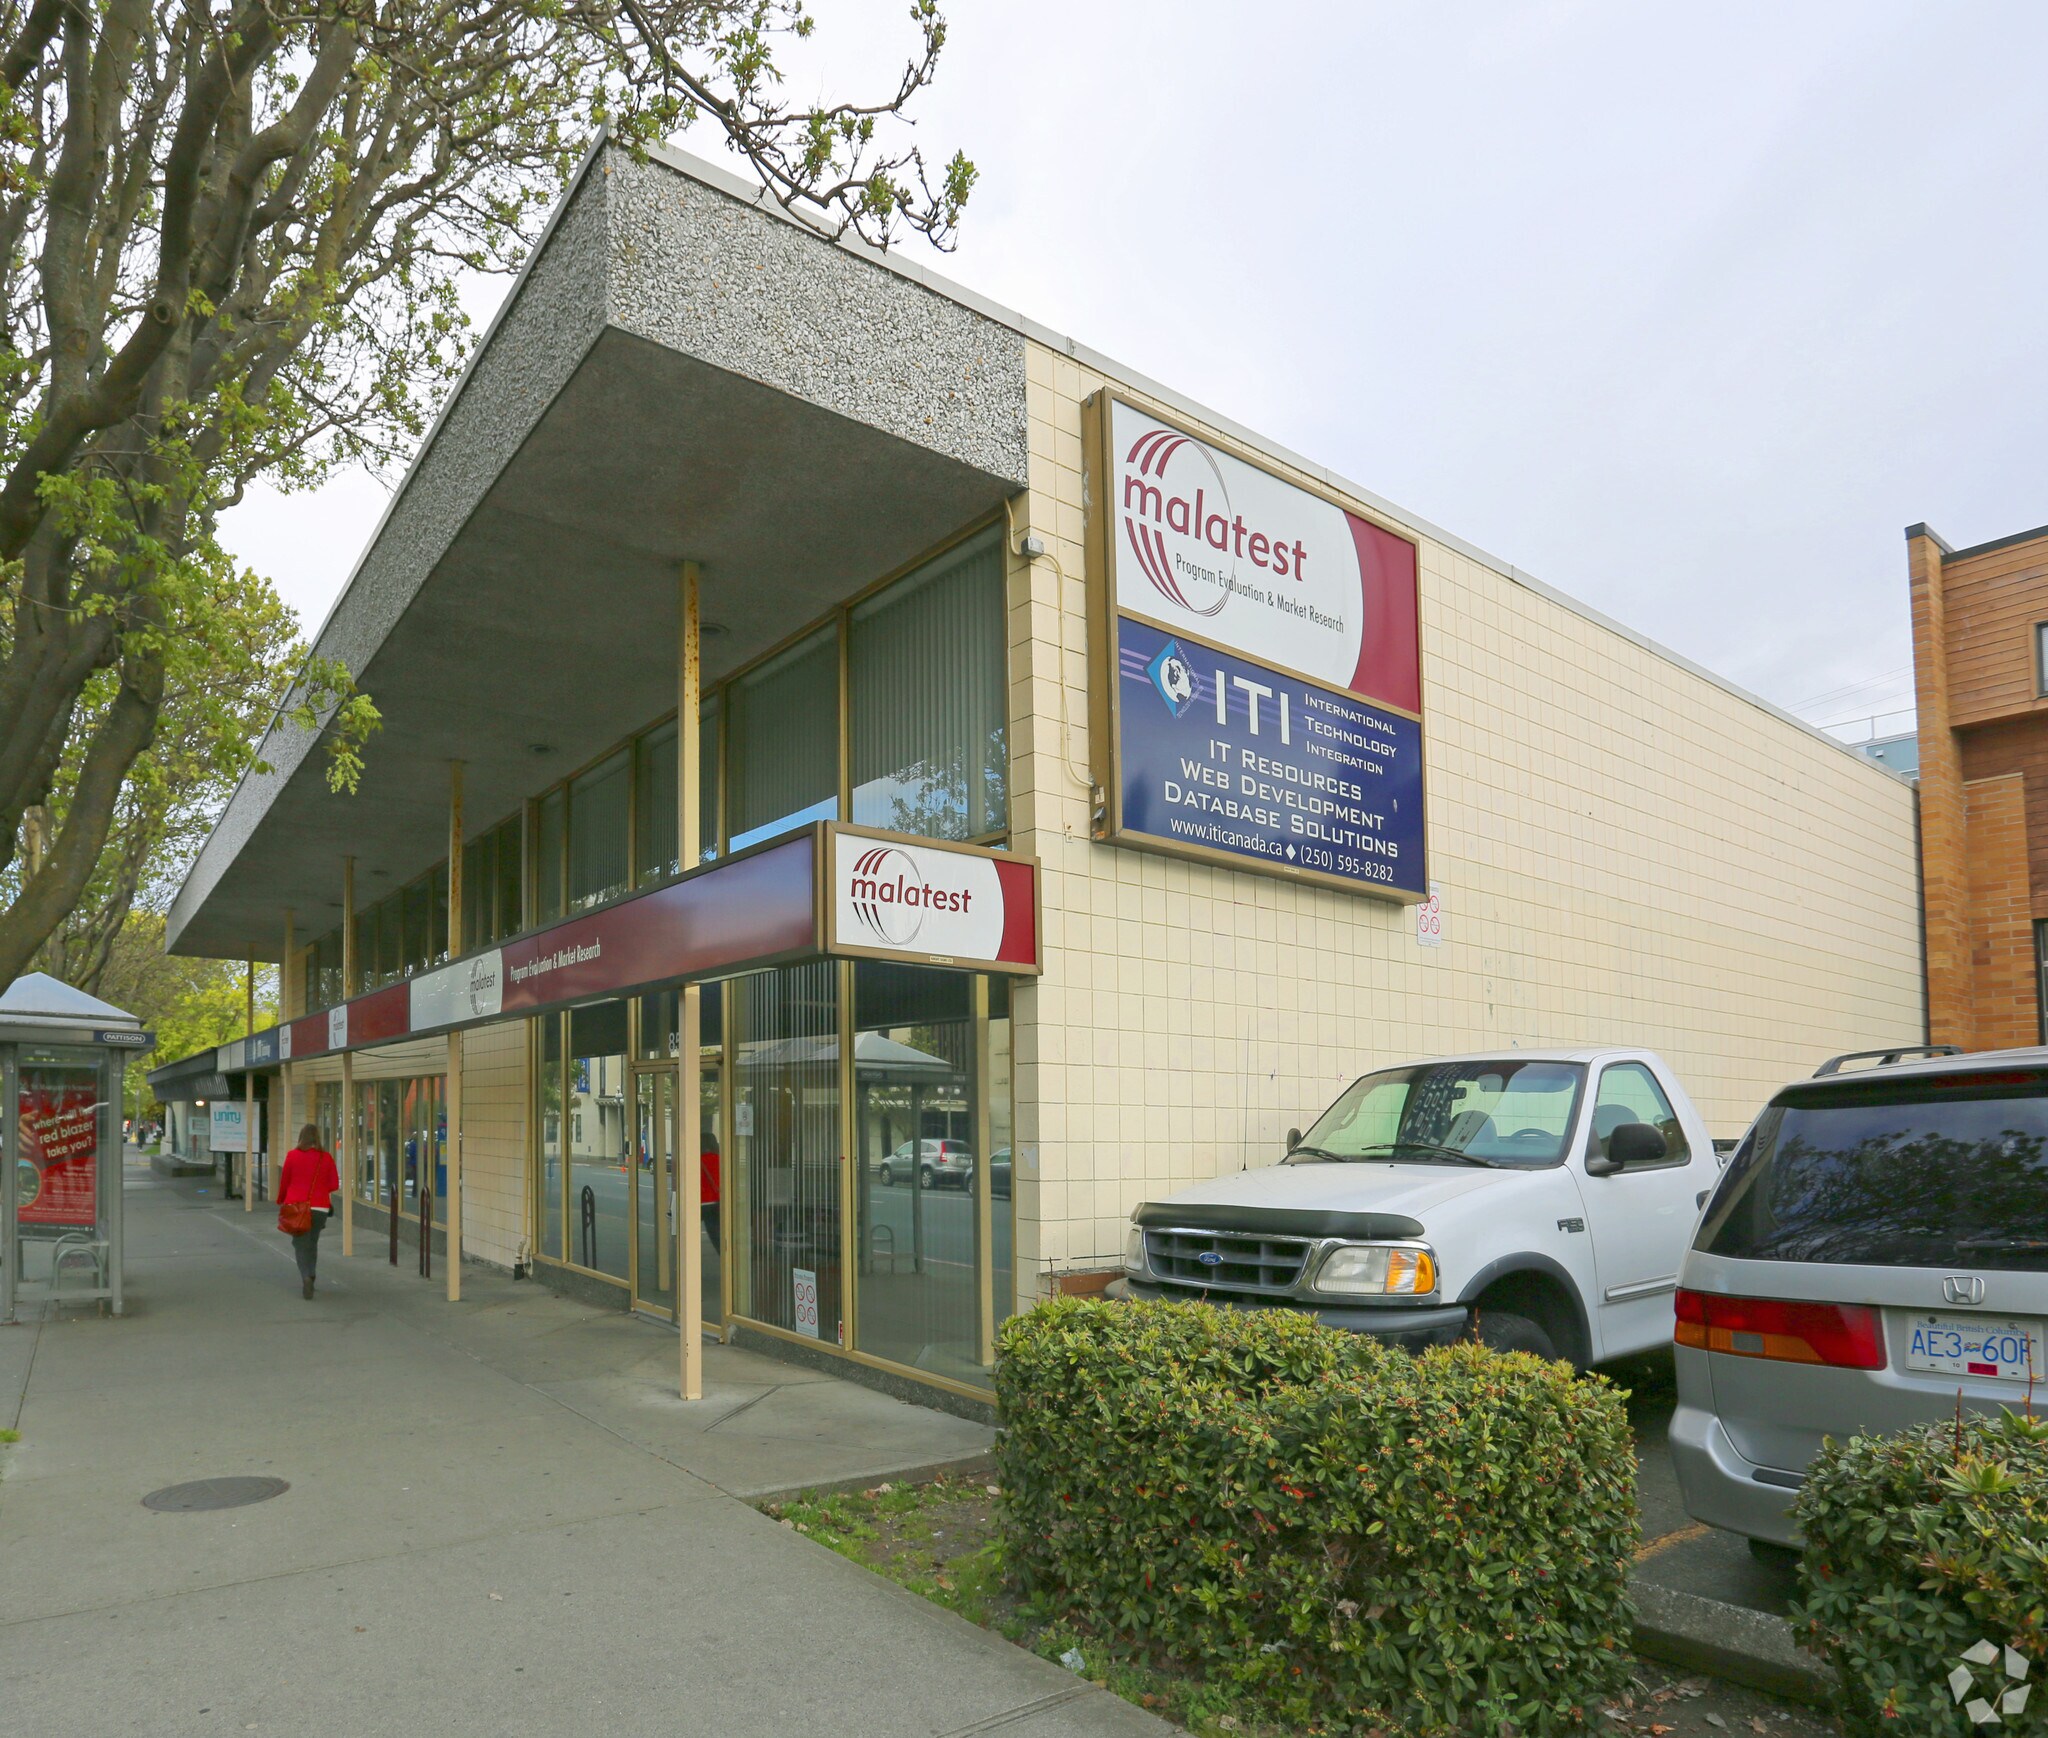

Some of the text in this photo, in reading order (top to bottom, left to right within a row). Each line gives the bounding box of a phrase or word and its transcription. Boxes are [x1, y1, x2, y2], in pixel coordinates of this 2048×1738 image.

[1124, 474, 1307, 582] malatest
[1176, 553, 1344, 634] Program Evaluation & Market Research
[1216, 669, 1291, 745] ITI
[1209, 739, 1232, 763] IT
[1170, 817, 1394, 882] www.iticanada.ca (250) 595-8282
[851, 874, 972, 914] malatest
[470, 937, 600, 993] malatest Program Evaluation & Market Research
[105, 1033, 143, 1042] PATTISON
[32, 1115, 61, 1130] where
[63, 1109, 77, 1120] will
[39, 1121, 93, 1145] red blazer
[46, 1135, 92, 1158] take you?
[1917, 1320, 1954, 1331] Beautiful
[1956, 1322, 1984, 1334] British
